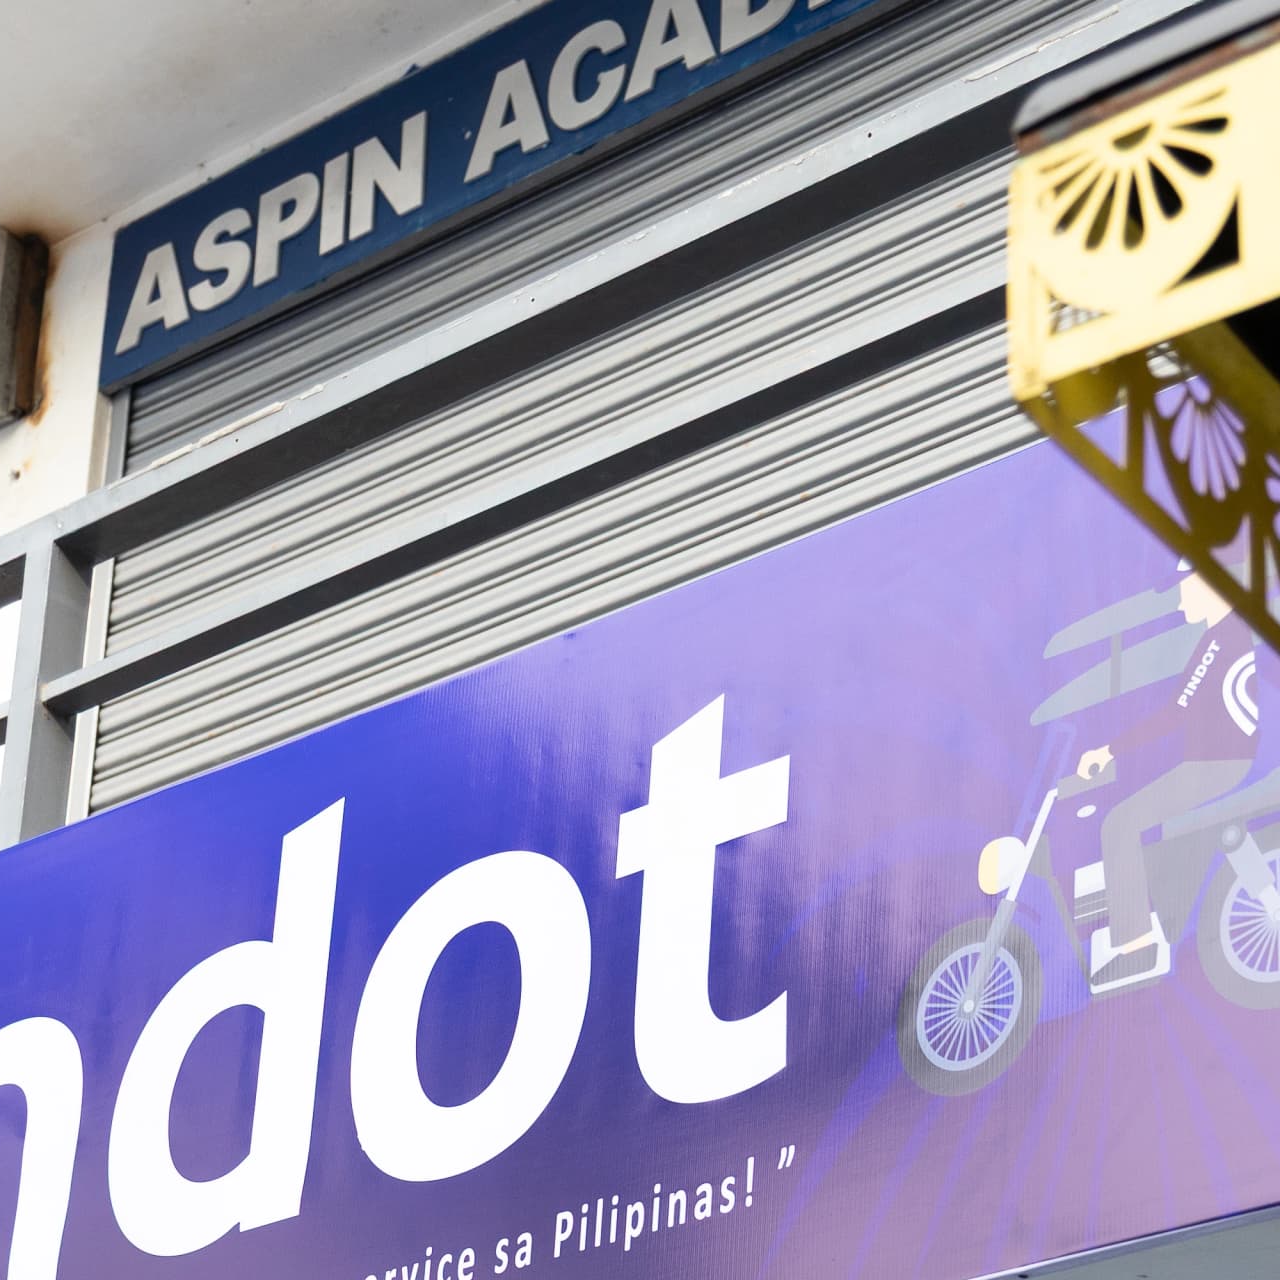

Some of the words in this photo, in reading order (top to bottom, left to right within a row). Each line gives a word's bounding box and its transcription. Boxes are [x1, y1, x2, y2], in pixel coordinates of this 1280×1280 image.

[115, 111, 427, 356] ASPIN
[464, 0, 828, 184] ACAD
[1177, 640, 1220, 708] PINDOT
[494, 1232, 532, 1275] sa
[553, 1157, 756, 1258] Pilipinas!
